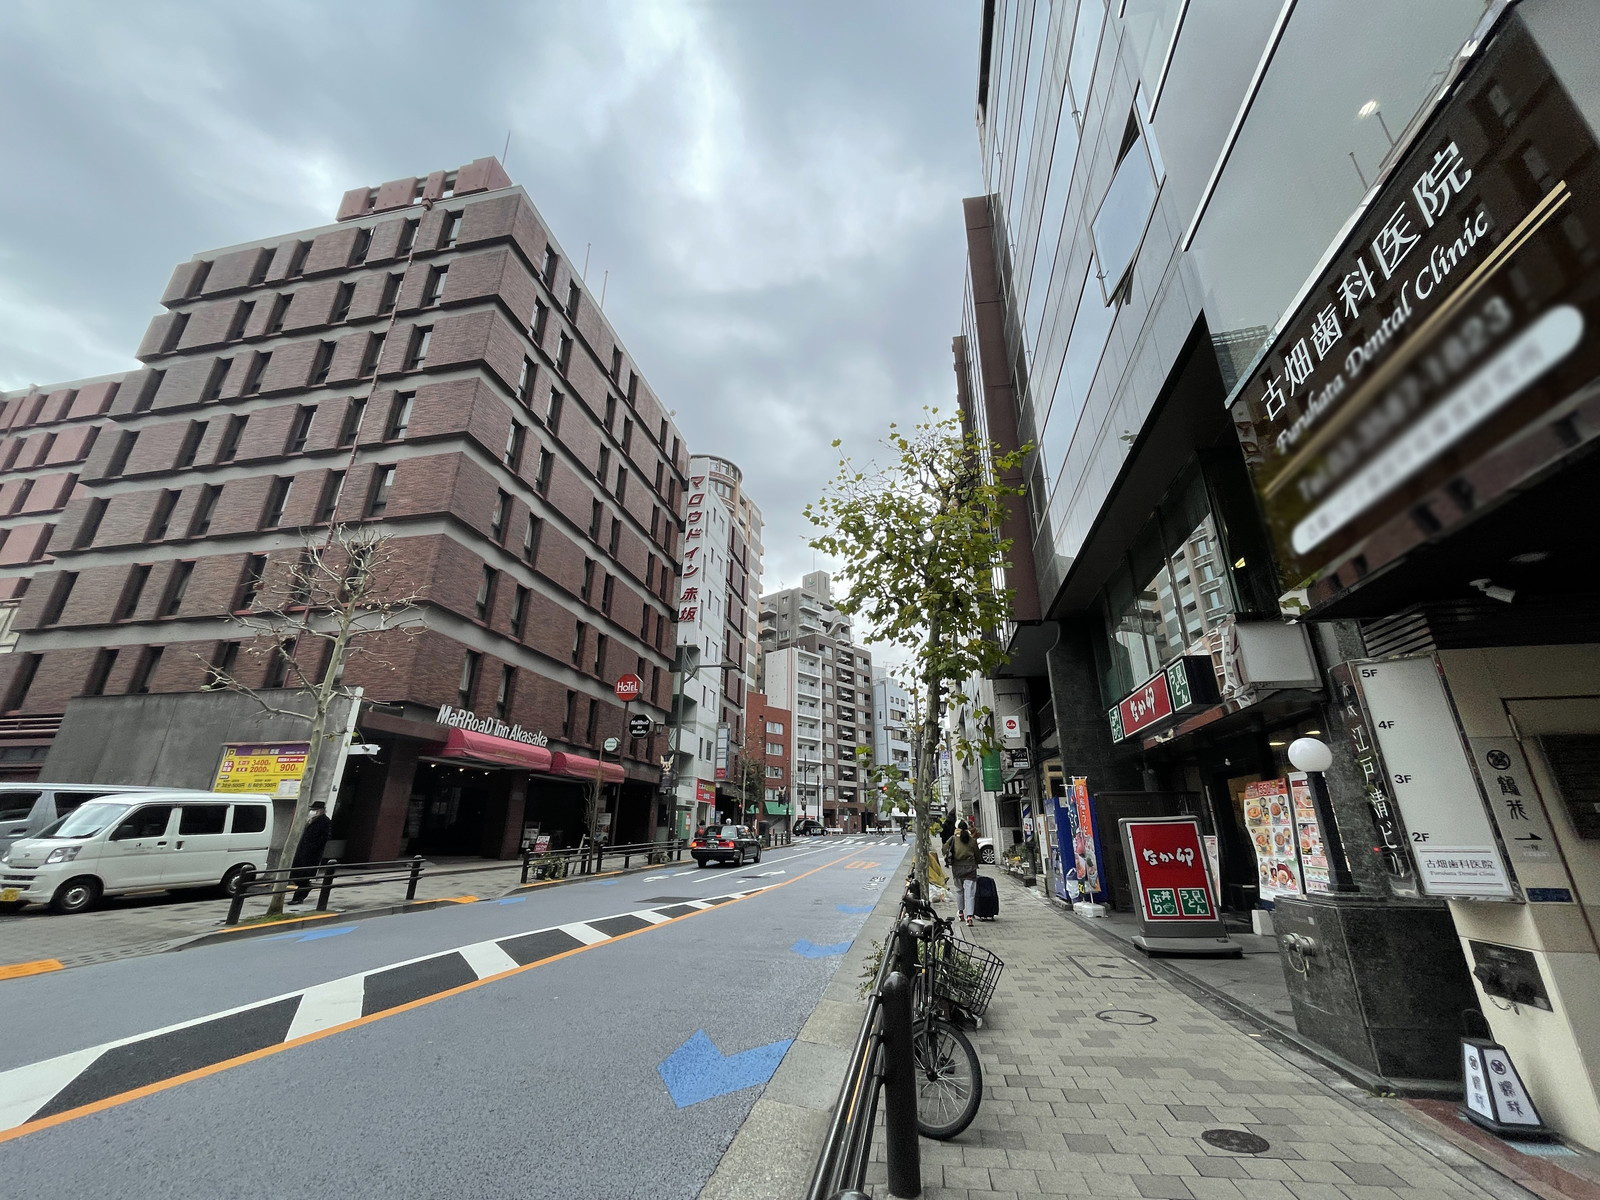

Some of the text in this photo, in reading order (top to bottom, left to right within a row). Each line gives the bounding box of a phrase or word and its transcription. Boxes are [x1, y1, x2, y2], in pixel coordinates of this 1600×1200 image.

[1261, 141, 1472, 421] 古畑歯科医院
[1277, 211, 1488, 454] Furuhata Dental Clinic
[679, 475, 705, 622] マロウドイン赤坂
[1362, 669, 1378, 678] 5F
[1130, 687, 1155, 722] なか卯
[1378, 720, 1395, 729] 4F
[509, 724, 549, 748] Akasaka
[1394, 774, 1412, 784] 3F
[1412, 832, 1430, 842] 2F
[1142, 847, 1194, 867] なか卯
[1425, 859, 1495, 869] 古畑歯科医院
[1180, 890, 1206, 914] うどん
